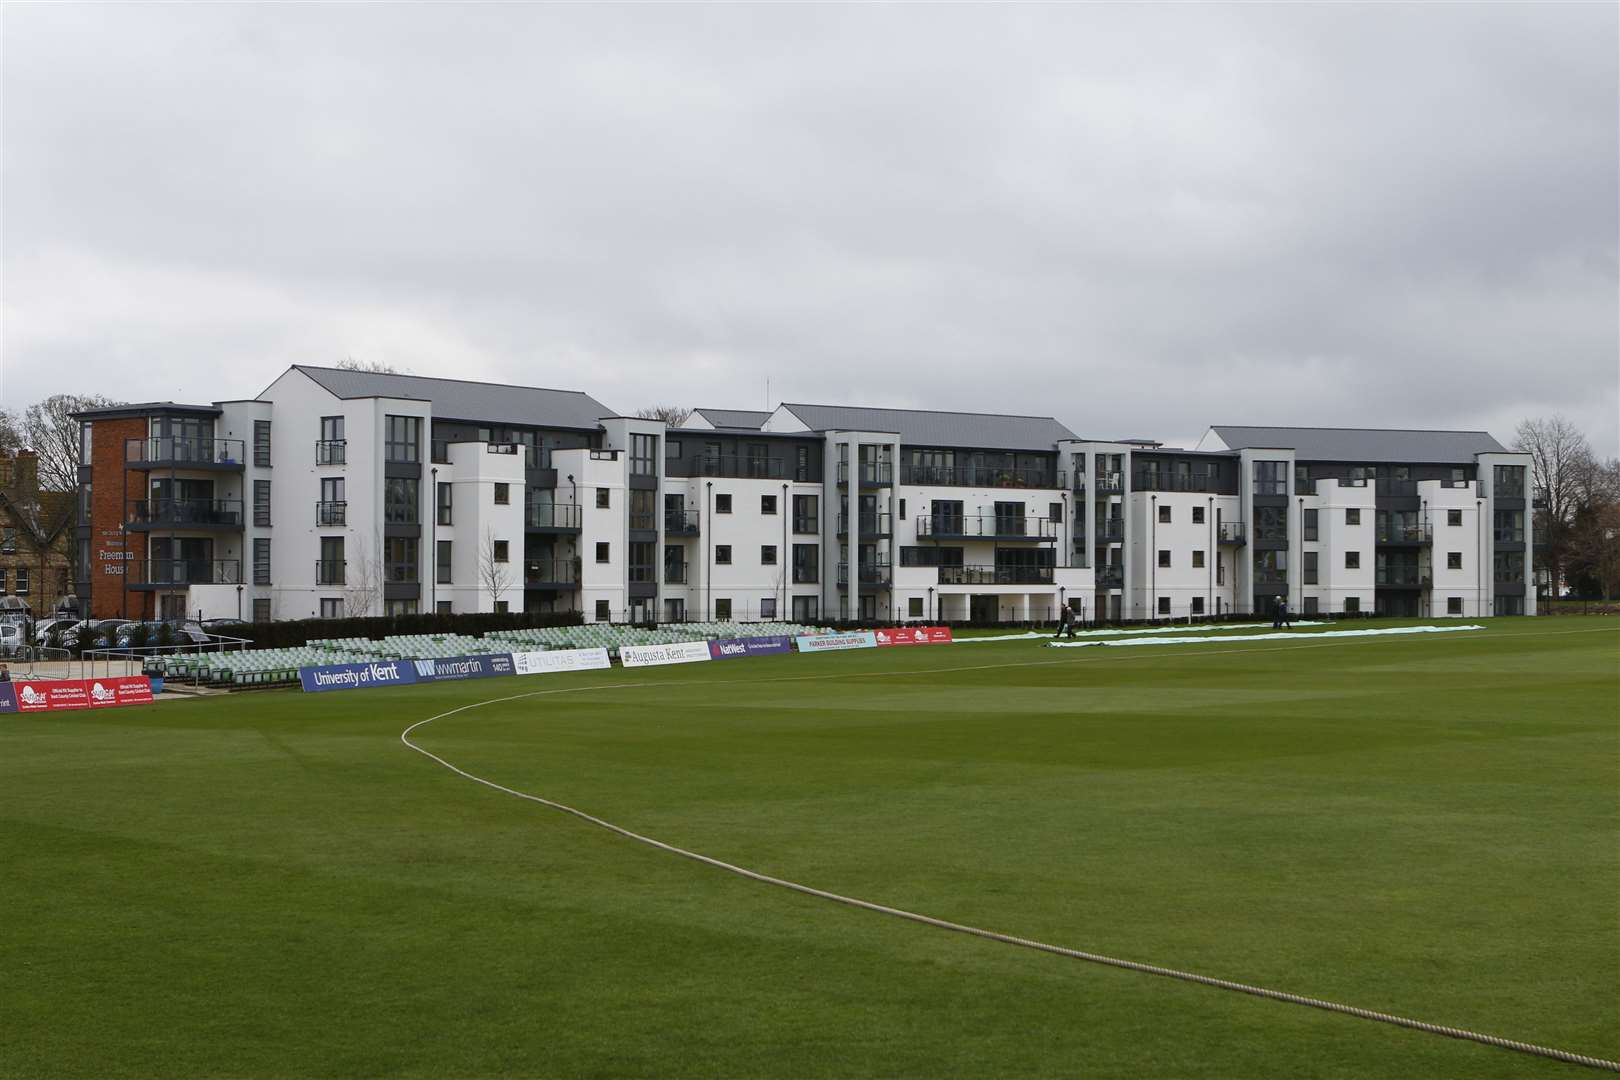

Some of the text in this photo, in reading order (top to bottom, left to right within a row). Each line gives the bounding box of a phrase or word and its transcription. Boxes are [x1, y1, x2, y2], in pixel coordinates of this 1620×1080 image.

[632, 650, 665, 664] Augusta
[665, 647, 685, 660] Kent
[719, 642, 746, 655] NatWest
[435, 658, 482, 675] wwmartin
[529, 655, 575, 667] UTILITAS
[313, 662, 400, 686] University of Kent
